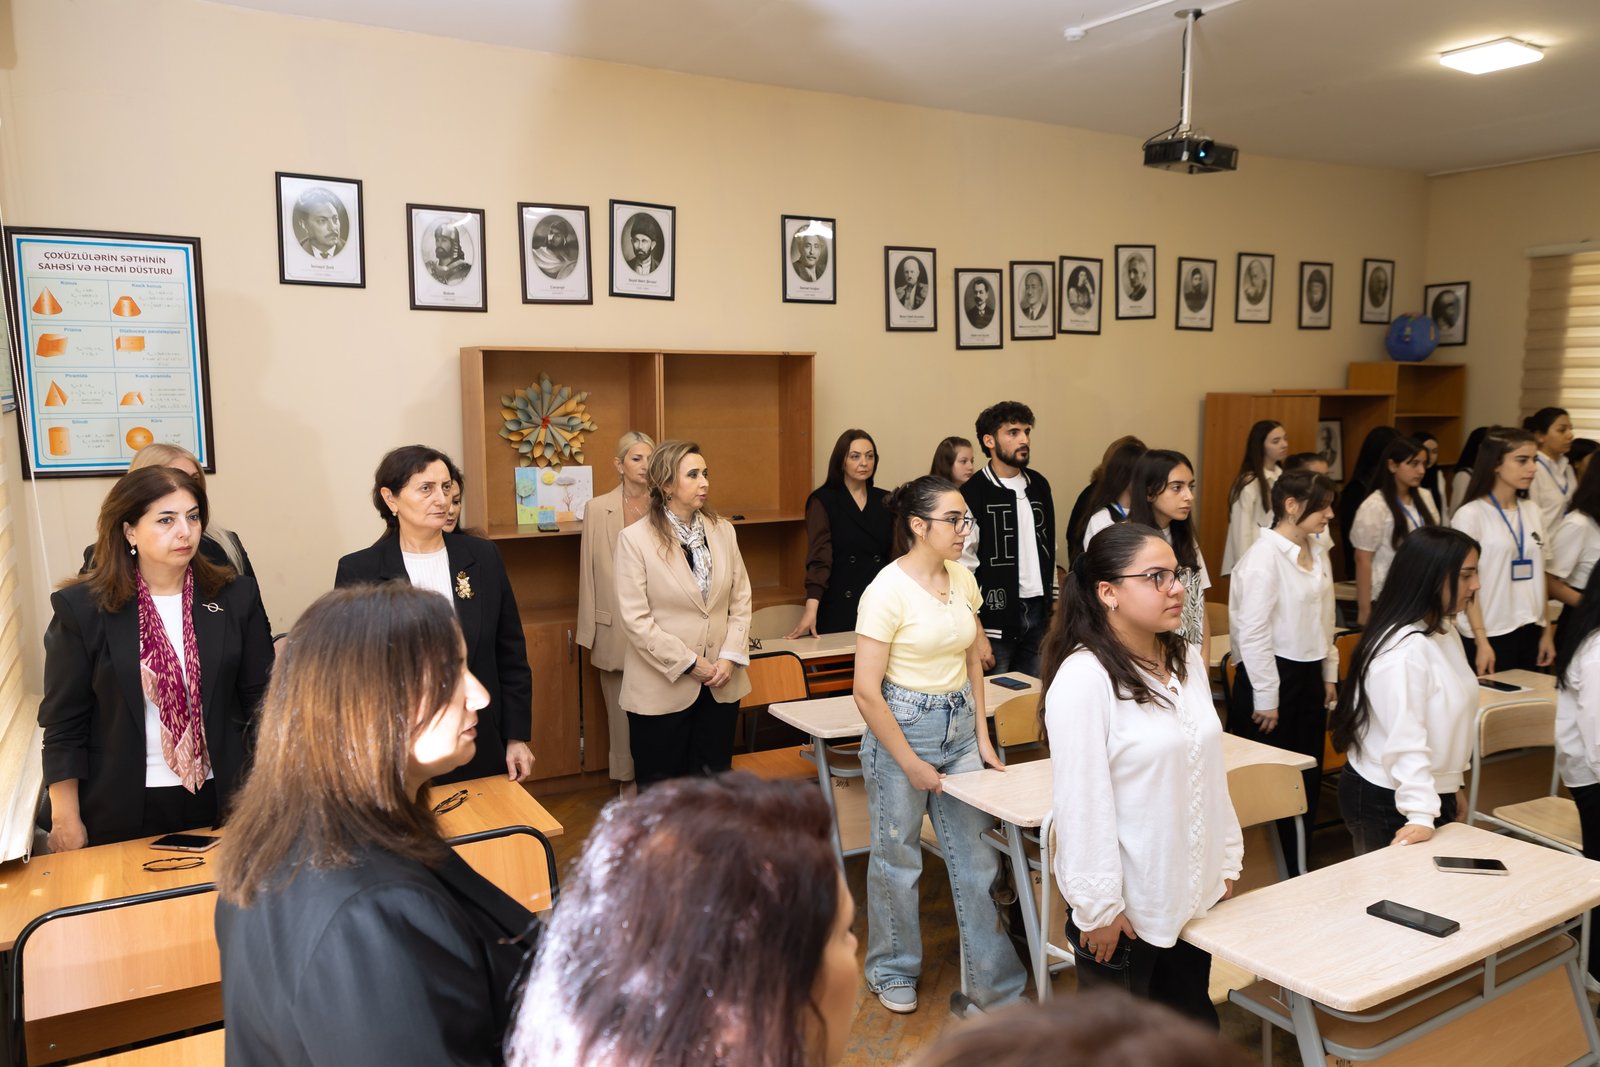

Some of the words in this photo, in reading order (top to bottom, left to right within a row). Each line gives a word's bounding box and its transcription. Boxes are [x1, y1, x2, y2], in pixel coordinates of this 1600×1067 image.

[44, 251, 118, 262] ÇOXÜZLÜLƏRİN
[120, 255, 166, 264] SƏTHİNİN
[38, 262, 75, 271] SAHƏSİ
[77, 264, 91, 272] VƏ
[94, 265, 127, 273] HƏCMİ
[129, 266, 173, 275] DÜSTURU
[986, 588, 1007, 611] 49
